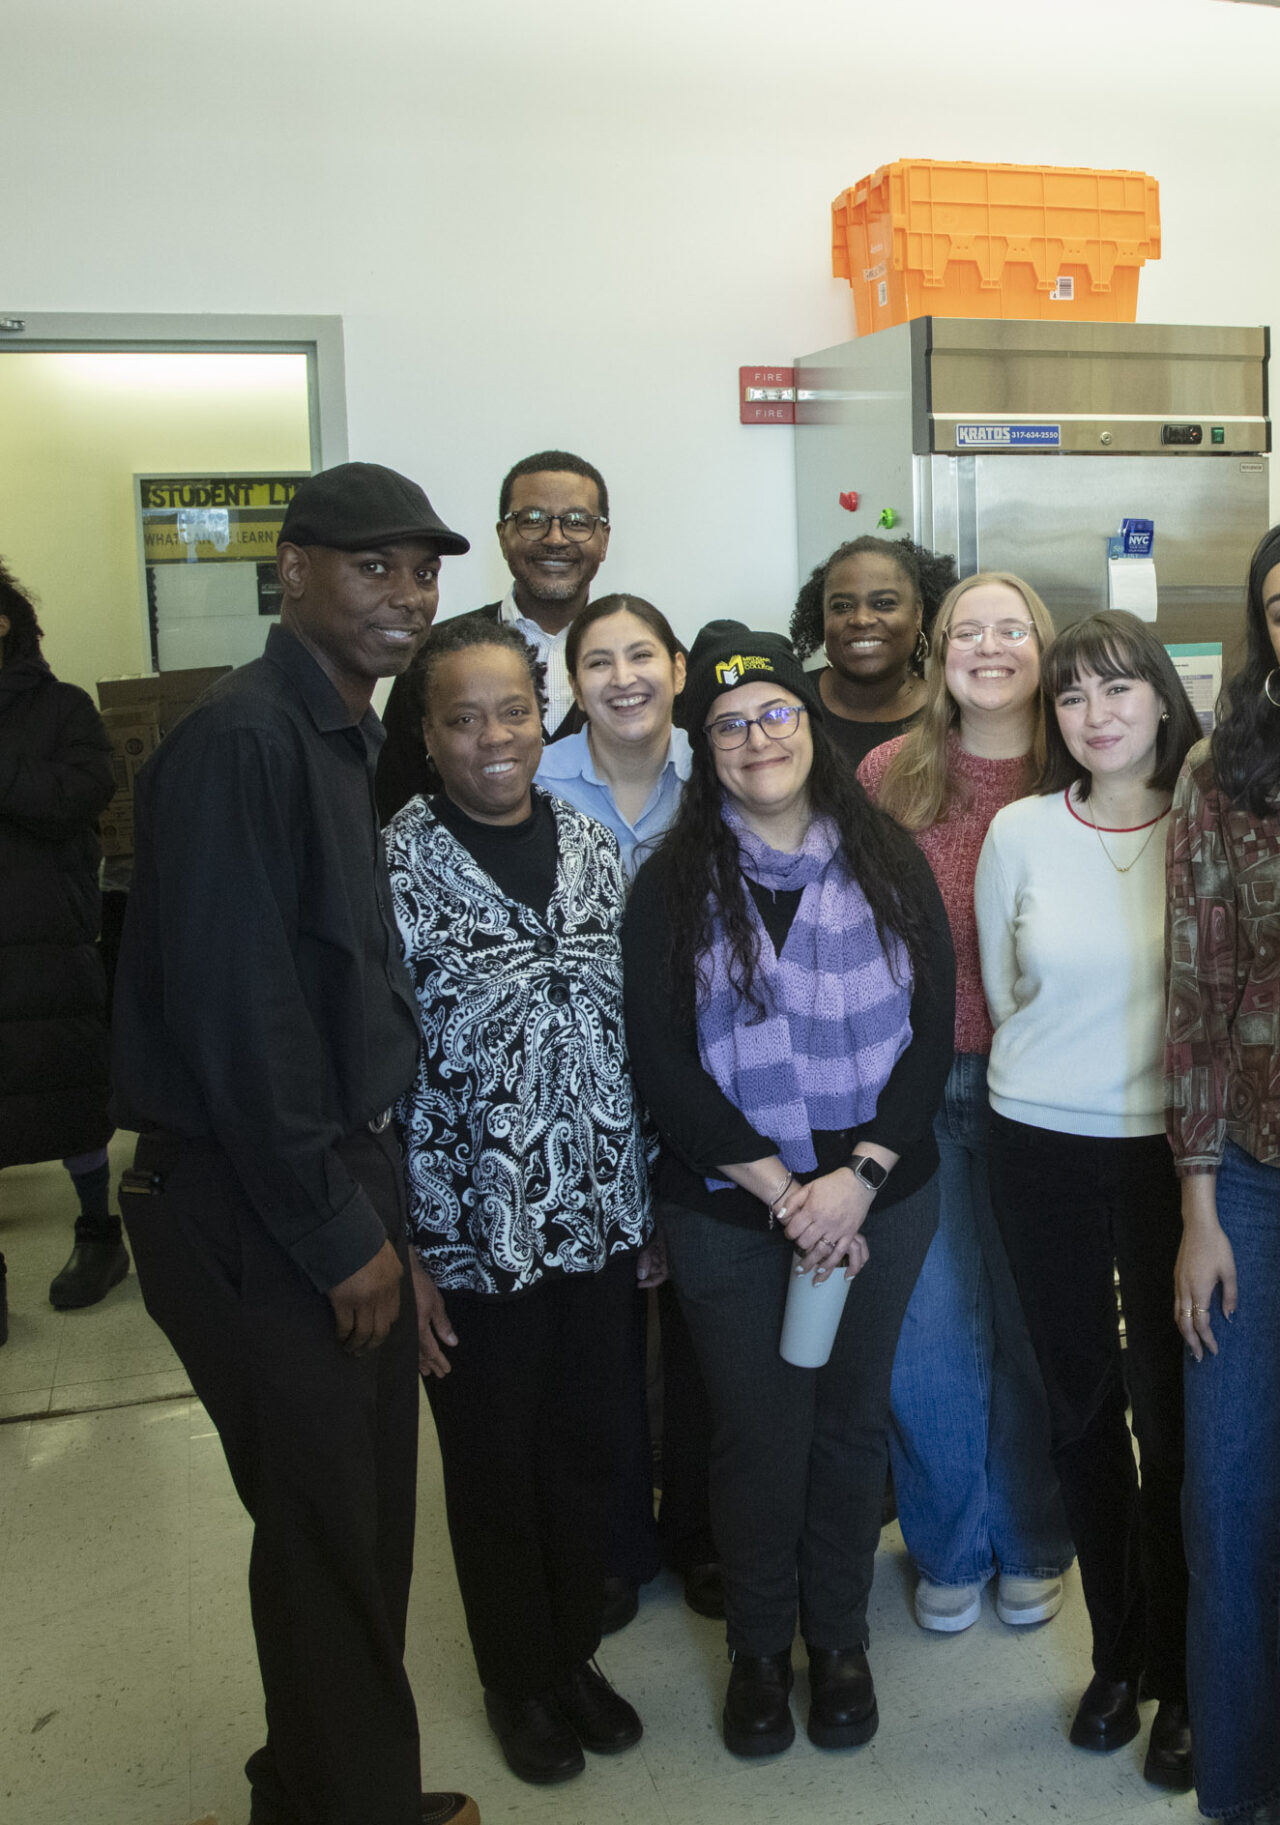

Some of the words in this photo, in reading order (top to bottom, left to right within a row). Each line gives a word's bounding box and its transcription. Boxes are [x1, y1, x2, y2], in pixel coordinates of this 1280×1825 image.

[754, 373, 783, 382] FIRE
[755, 409, 783, 418] FIRE
[960, 427, 1010, 441] KRATOS
[1011, 431, 1059, 439] 317-634-2550
[151, 484, 254, 508] STUDENT
[145, 533, 179, 546] WHAT
[236, 530, 274, 545] LEARN
[1128, 536, 1150, 545] NYC
